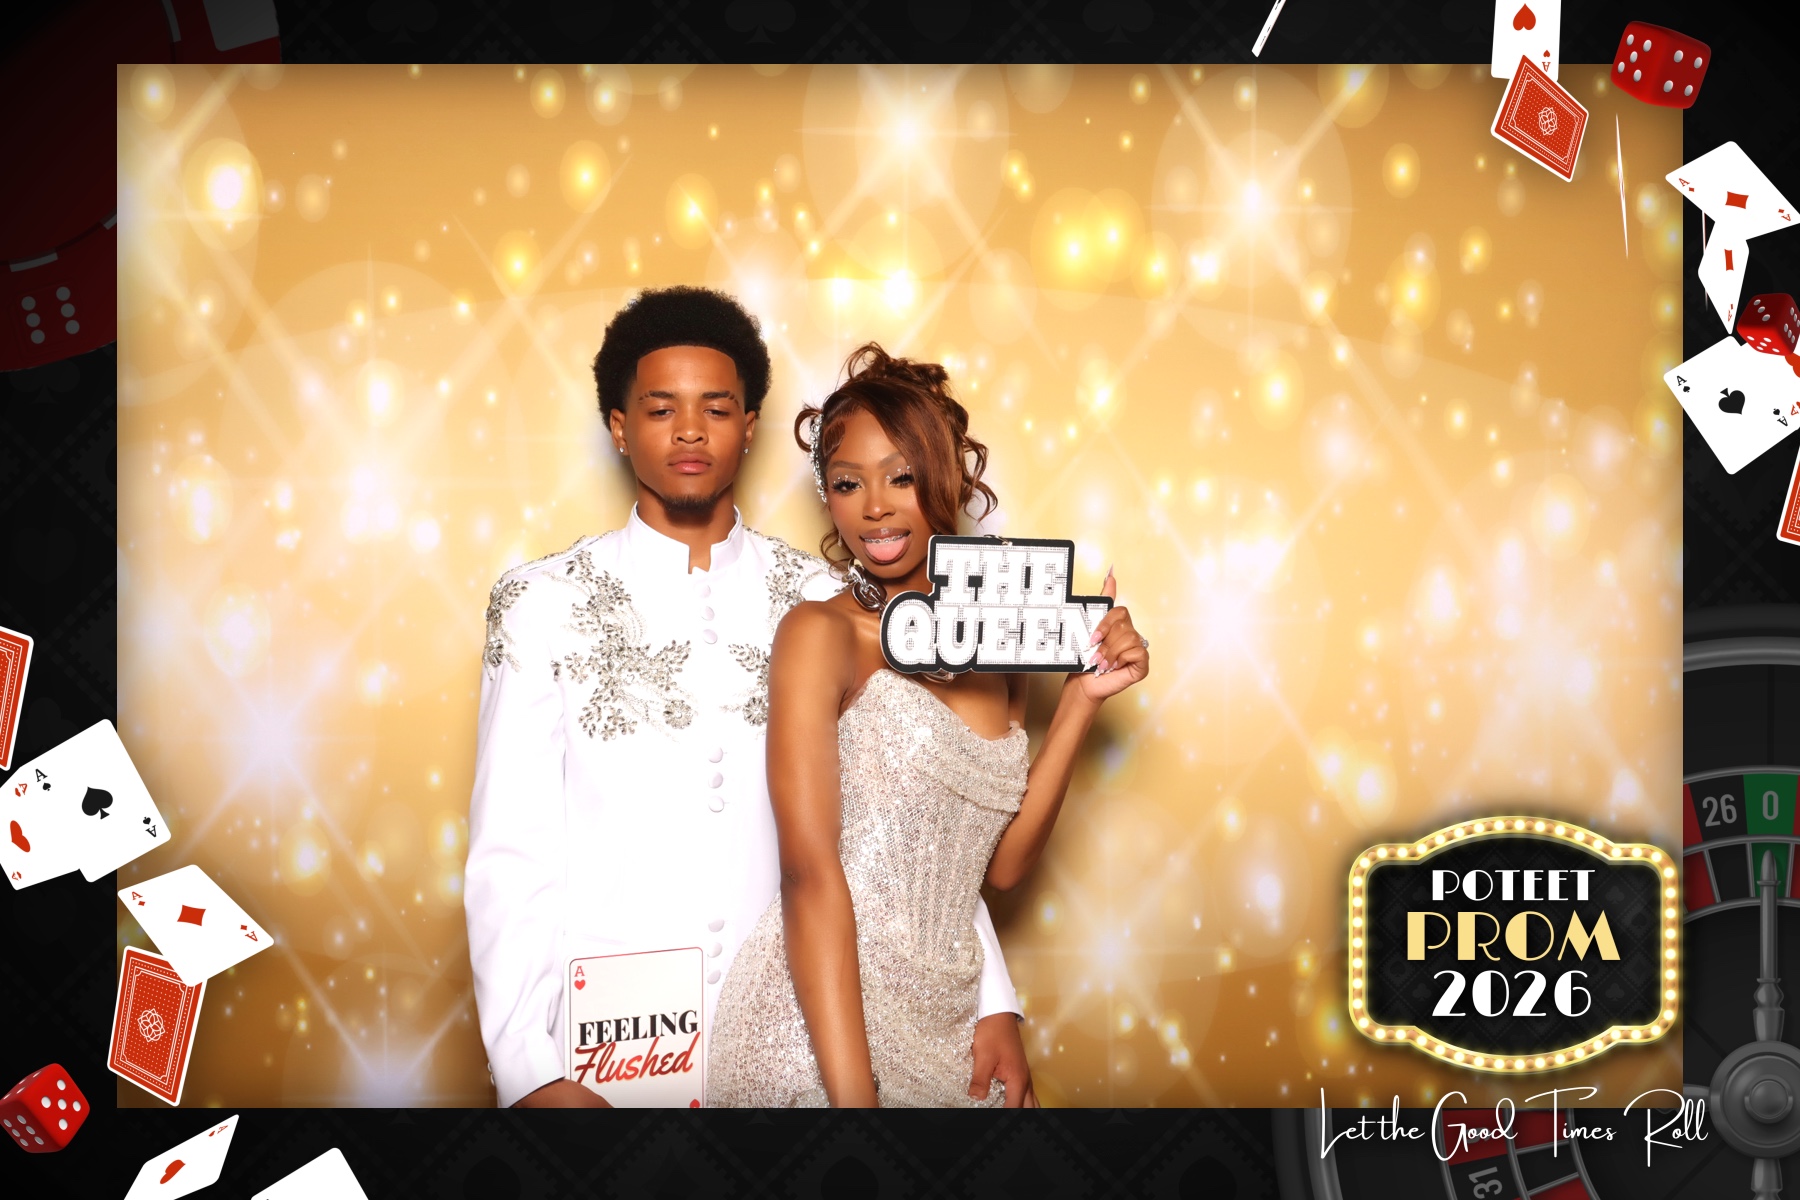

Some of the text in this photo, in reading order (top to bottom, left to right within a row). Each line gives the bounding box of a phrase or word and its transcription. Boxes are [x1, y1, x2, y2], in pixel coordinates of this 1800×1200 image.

[934, 543, 1070, 605] THE
[886, 599, 1110, 666] QUEEN
[574, 965, 586, 978] A
[577, 1009, 699, 1047] FEELING
[574, 1031, 701, 1085] Flushed
